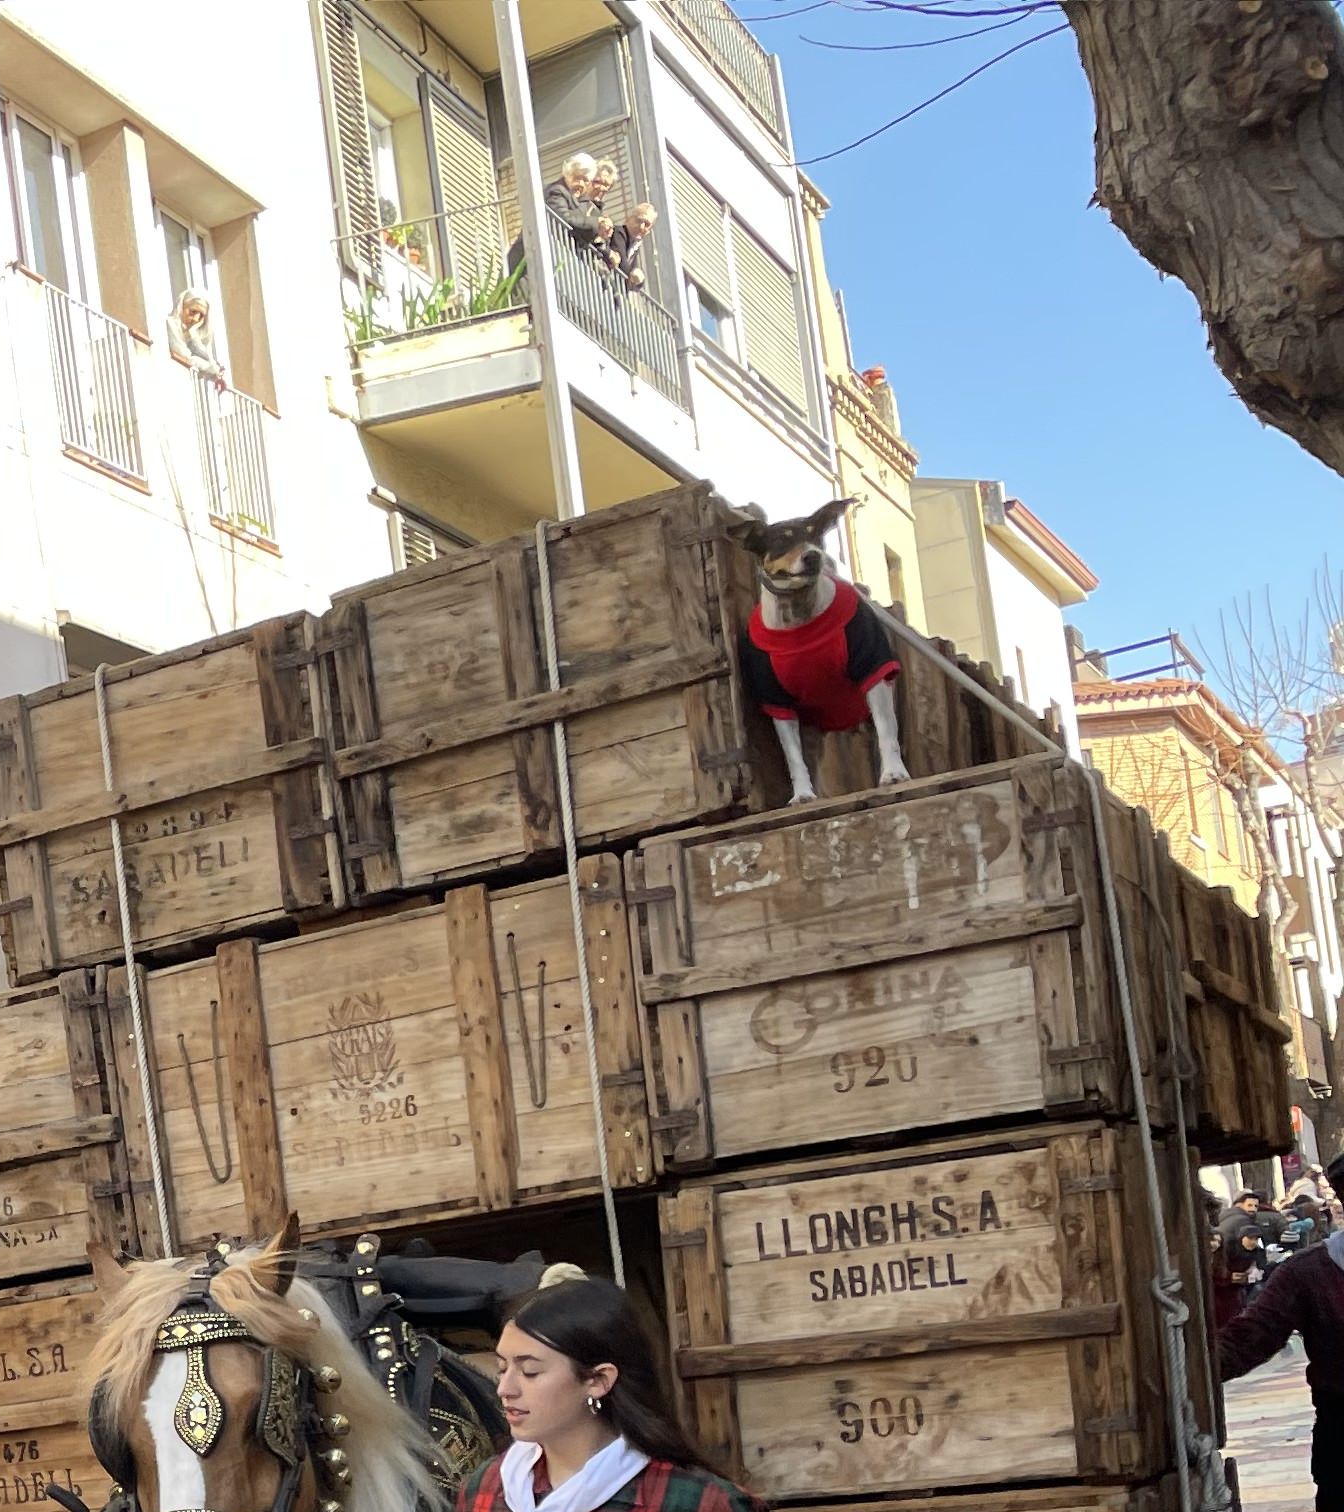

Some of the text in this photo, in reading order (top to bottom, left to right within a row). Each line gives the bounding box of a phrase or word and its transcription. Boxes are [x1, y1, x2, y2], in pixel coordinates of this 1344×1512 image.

[831, 1044, 920, 1094] 920
[359, 1094, 418, 1126] 5226
[810, 1252, 968, 1302] SABADELL
[837, 1394, 923, 1443] 900
